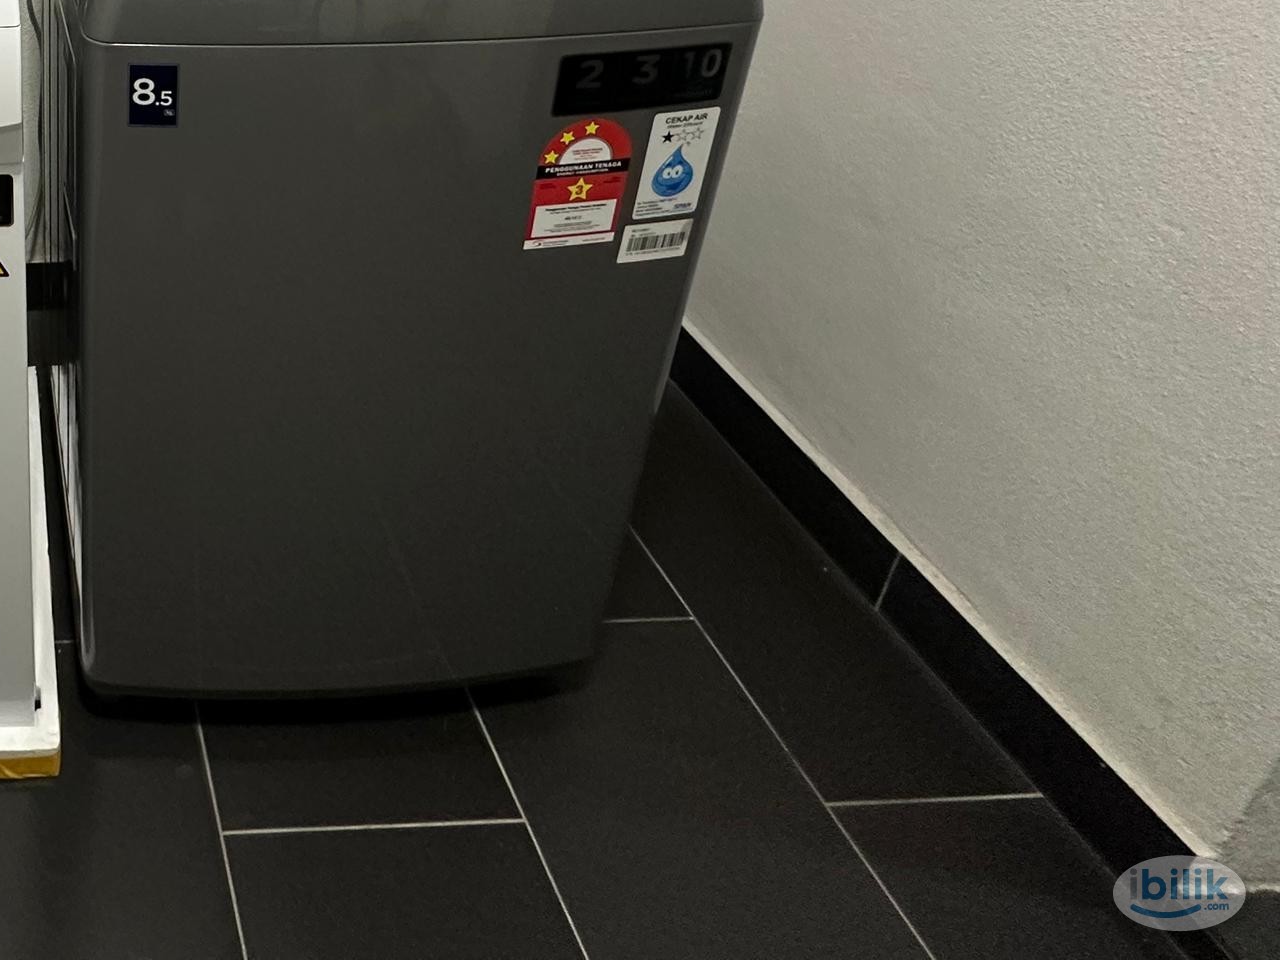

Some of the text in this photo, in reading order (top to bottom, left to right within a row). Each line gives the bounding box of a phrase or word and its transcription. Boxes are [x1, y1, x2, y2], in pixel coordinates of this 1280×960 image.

[576, 48, 724, 89] 2 3 10
[132, 78, 173, 105] 8.5
[665, 112, 708, 124] CEKAP AIR
[545, 160, 622, 174] PENGGUNAAN TENAGA
[575, 184, 584, 195] 3
